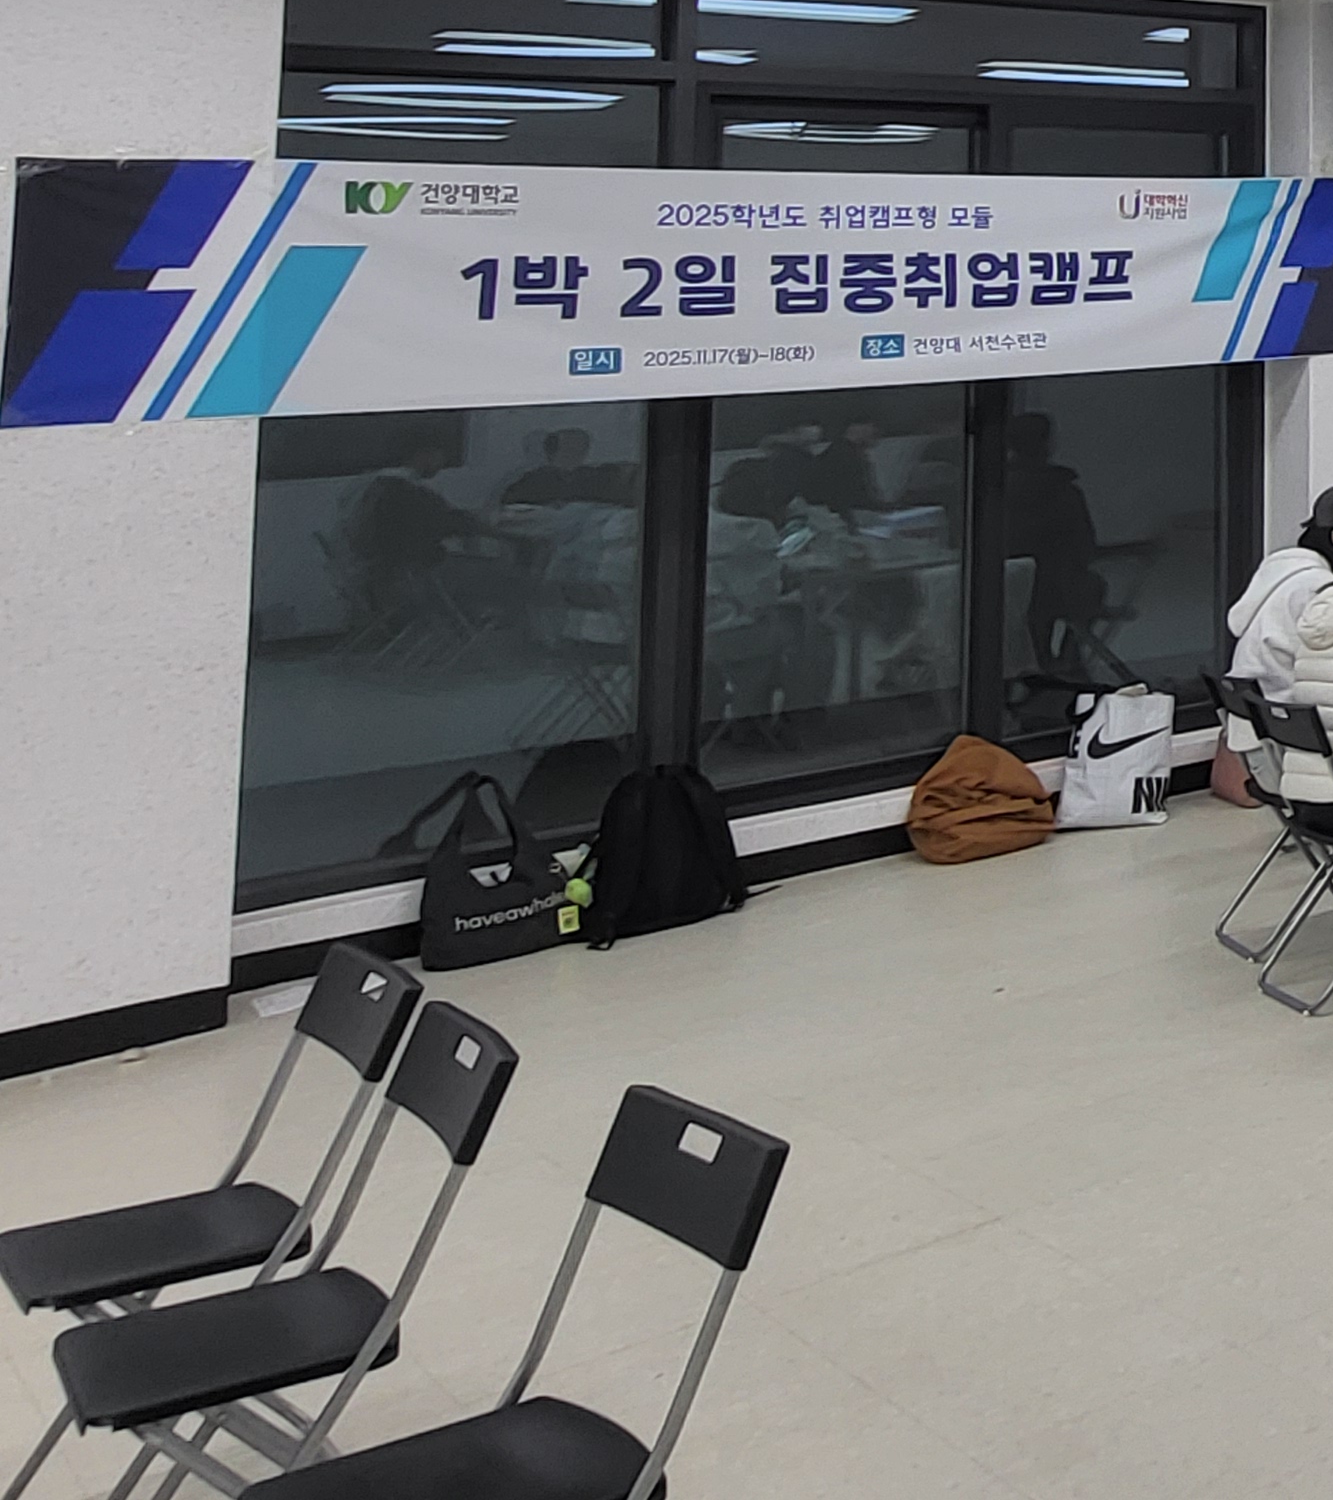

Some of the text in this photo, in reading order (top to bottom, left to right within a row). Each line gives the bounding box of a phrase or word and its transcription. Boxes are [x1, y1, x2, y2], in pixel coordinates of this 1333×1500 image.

[420, 183, 519, 205] 건양대학교
[656, 203, 994, 229] 2025학년도 취업캠프형 모듈
[460, 250, 1134, 321] 1박 2일 집중취업캠프
[865, 338, 901, 356] 장소
[912, 332, 1048, 355] 건양대 서천수련관
[573, 350, 616, 372] 일시
